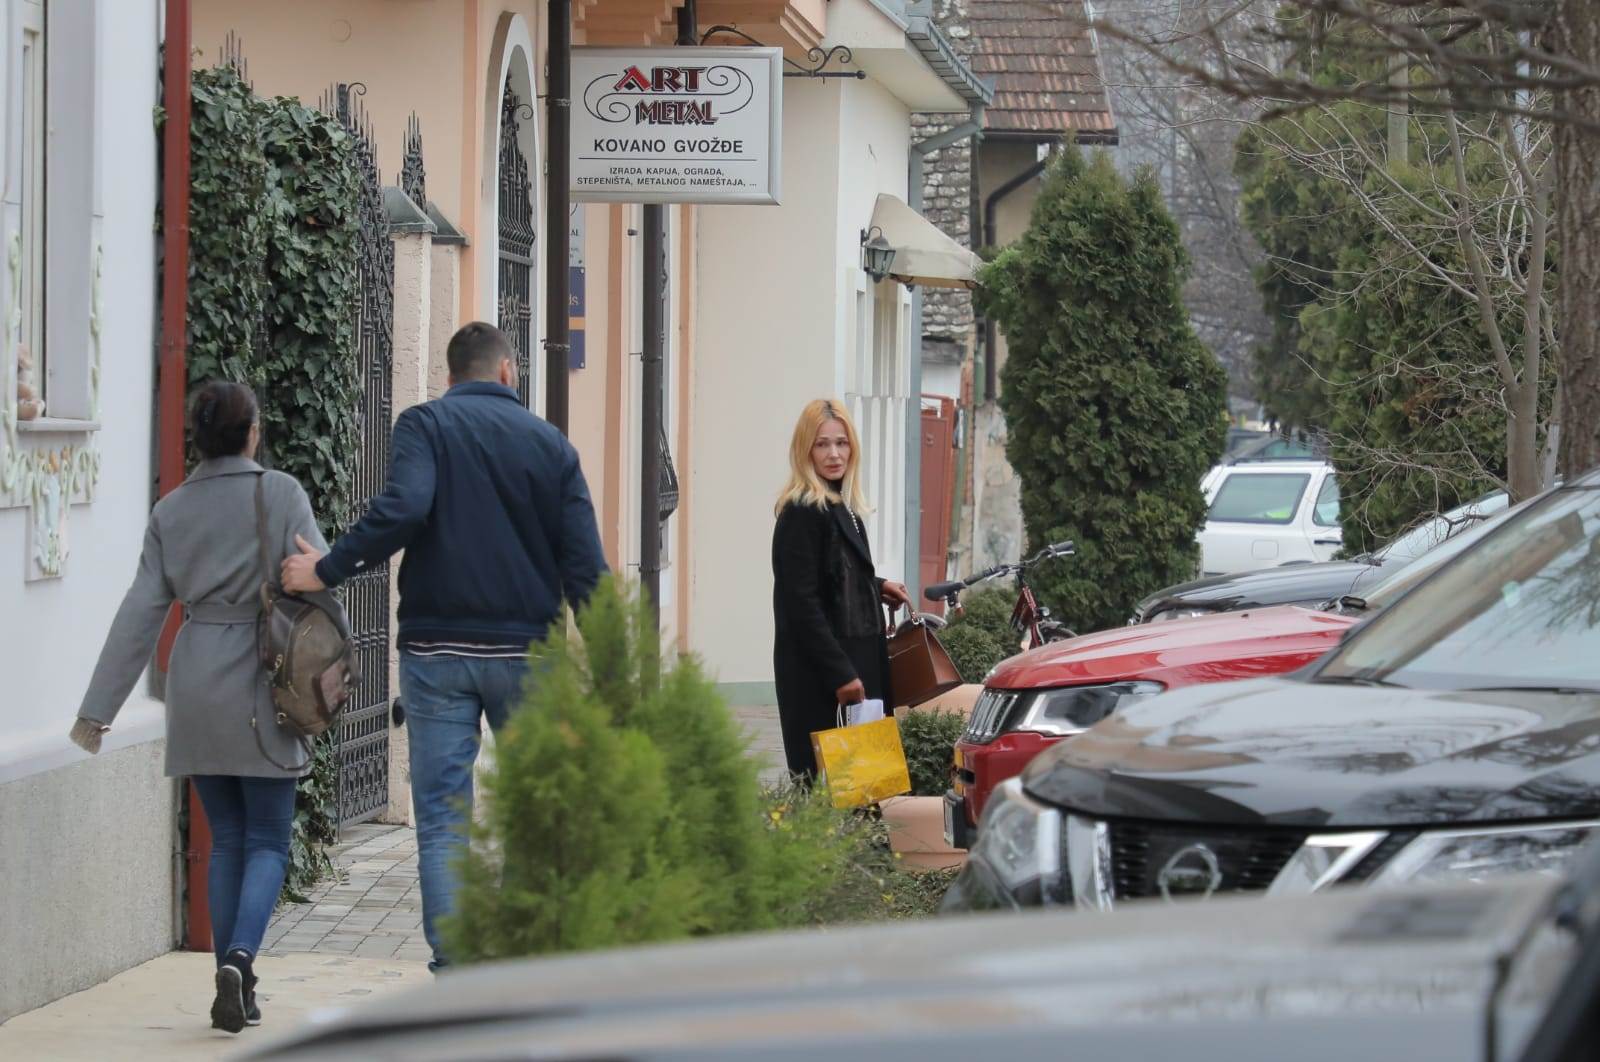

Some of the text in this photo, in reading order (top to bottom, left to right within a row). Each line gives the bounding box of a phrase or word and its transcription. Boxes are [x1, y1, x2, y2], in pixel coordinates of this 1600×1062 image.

[613, 65, 707, 93] ART
[635, 99, 720, 126] METAL
[594, 137, 743, 154] KOVANO GVOŽĐE
[609, 167, 724, 177] IZRADA KAPIJA, OGRADA,
[577, 175, 633, 186] STEPENIŠTA,
[637, 178, 686, 186] METALNOG
[690, 176, 746, 187] NAMEŠTAJA,
